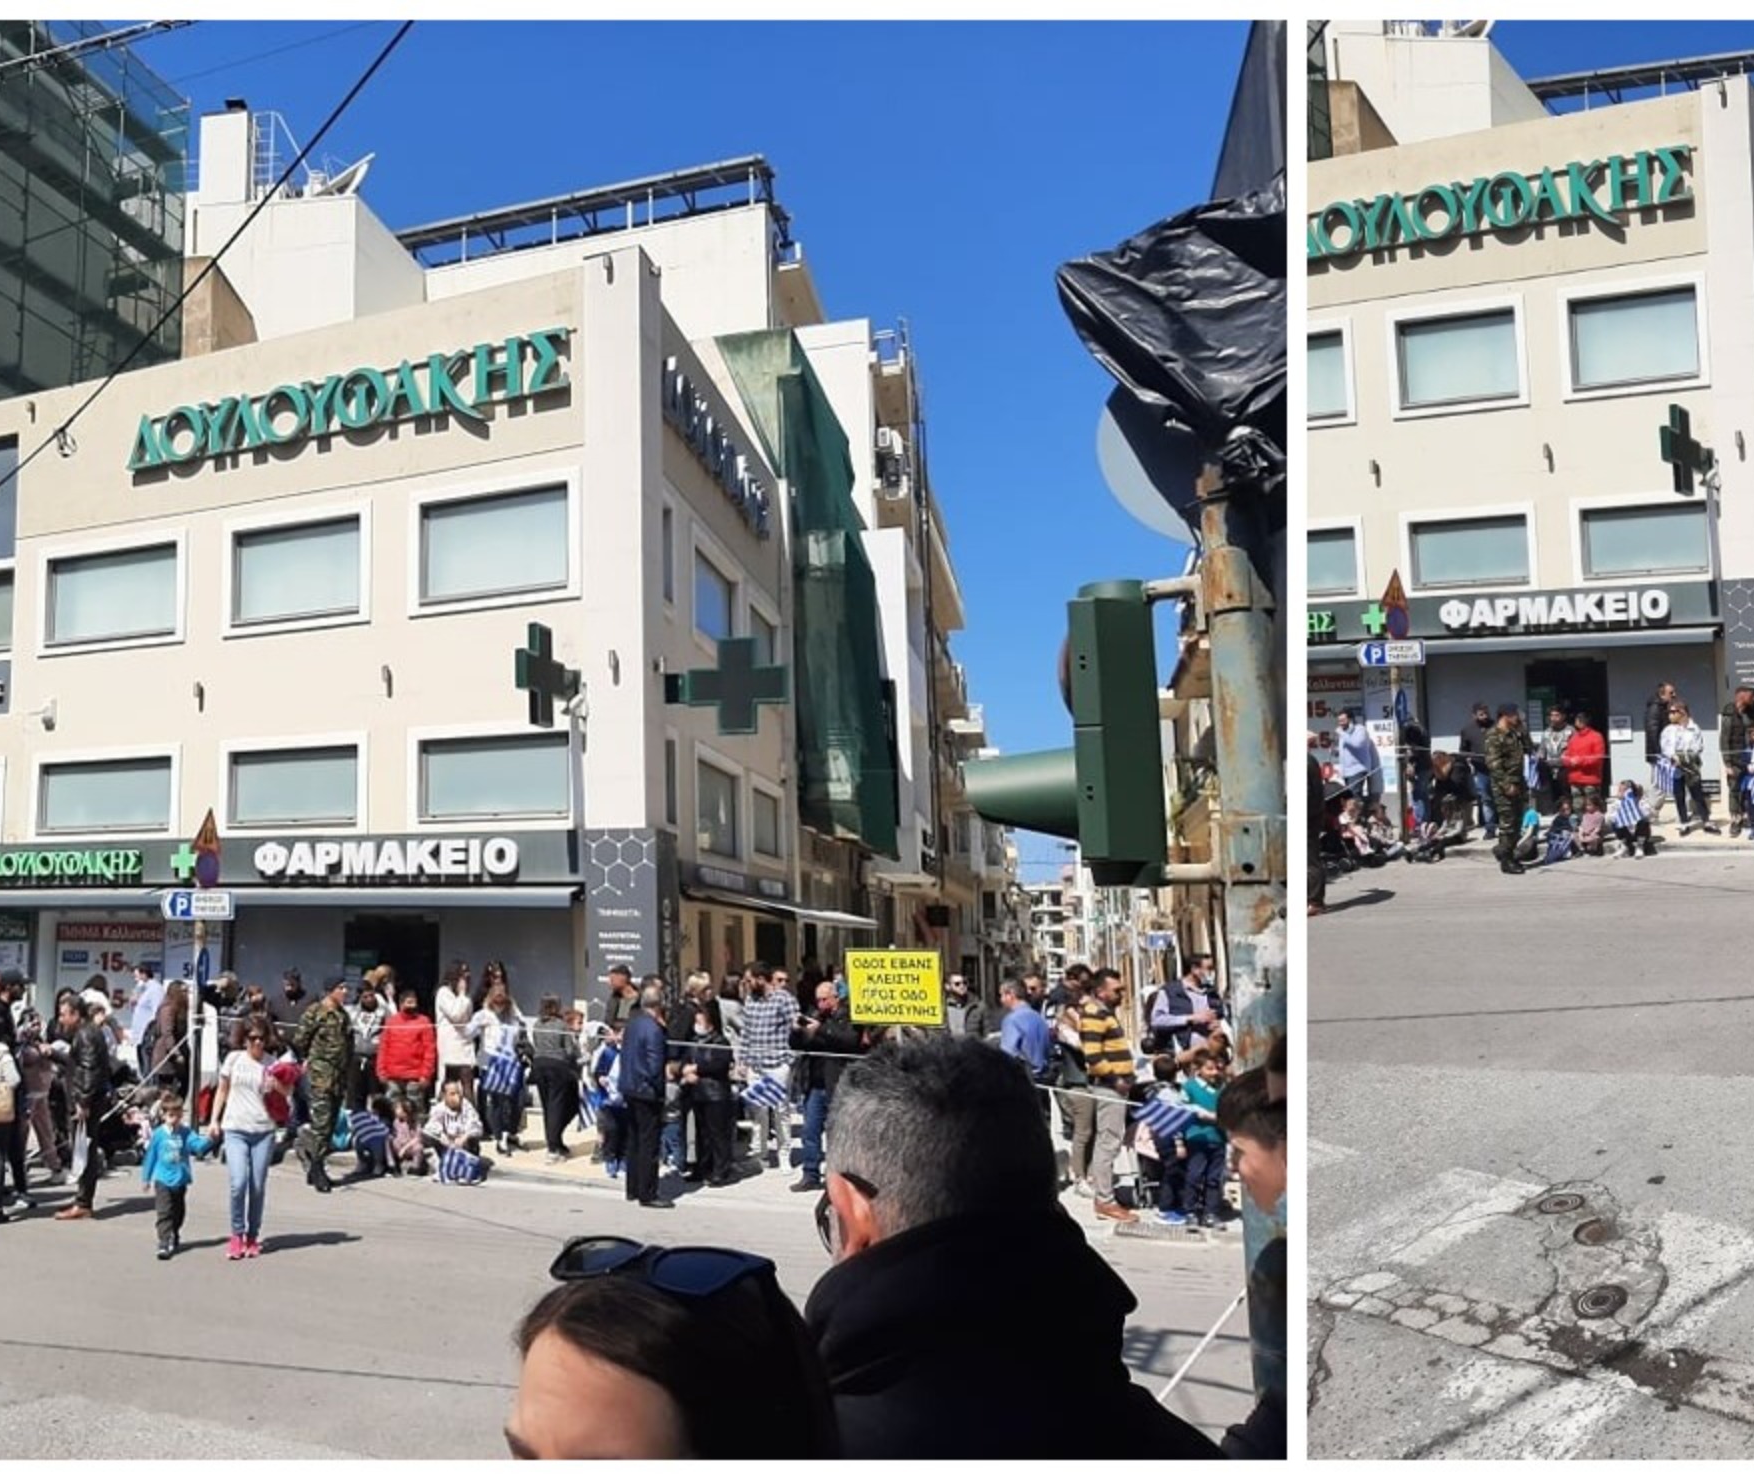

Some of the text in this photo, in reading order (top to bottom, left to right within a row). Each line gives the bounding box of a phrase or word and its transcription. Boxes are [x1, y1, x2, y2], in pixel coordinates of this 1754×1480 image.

[125, 326, 573, 472] ΔΟΥΛΟΥΦΑΚΗΣ
[1439, 589, 1670, 628] ΦΑΡΜΑΚΕΙΟ
[253, 837, 519, 876] ΦΑΡΜΑΚΕΙΟ
